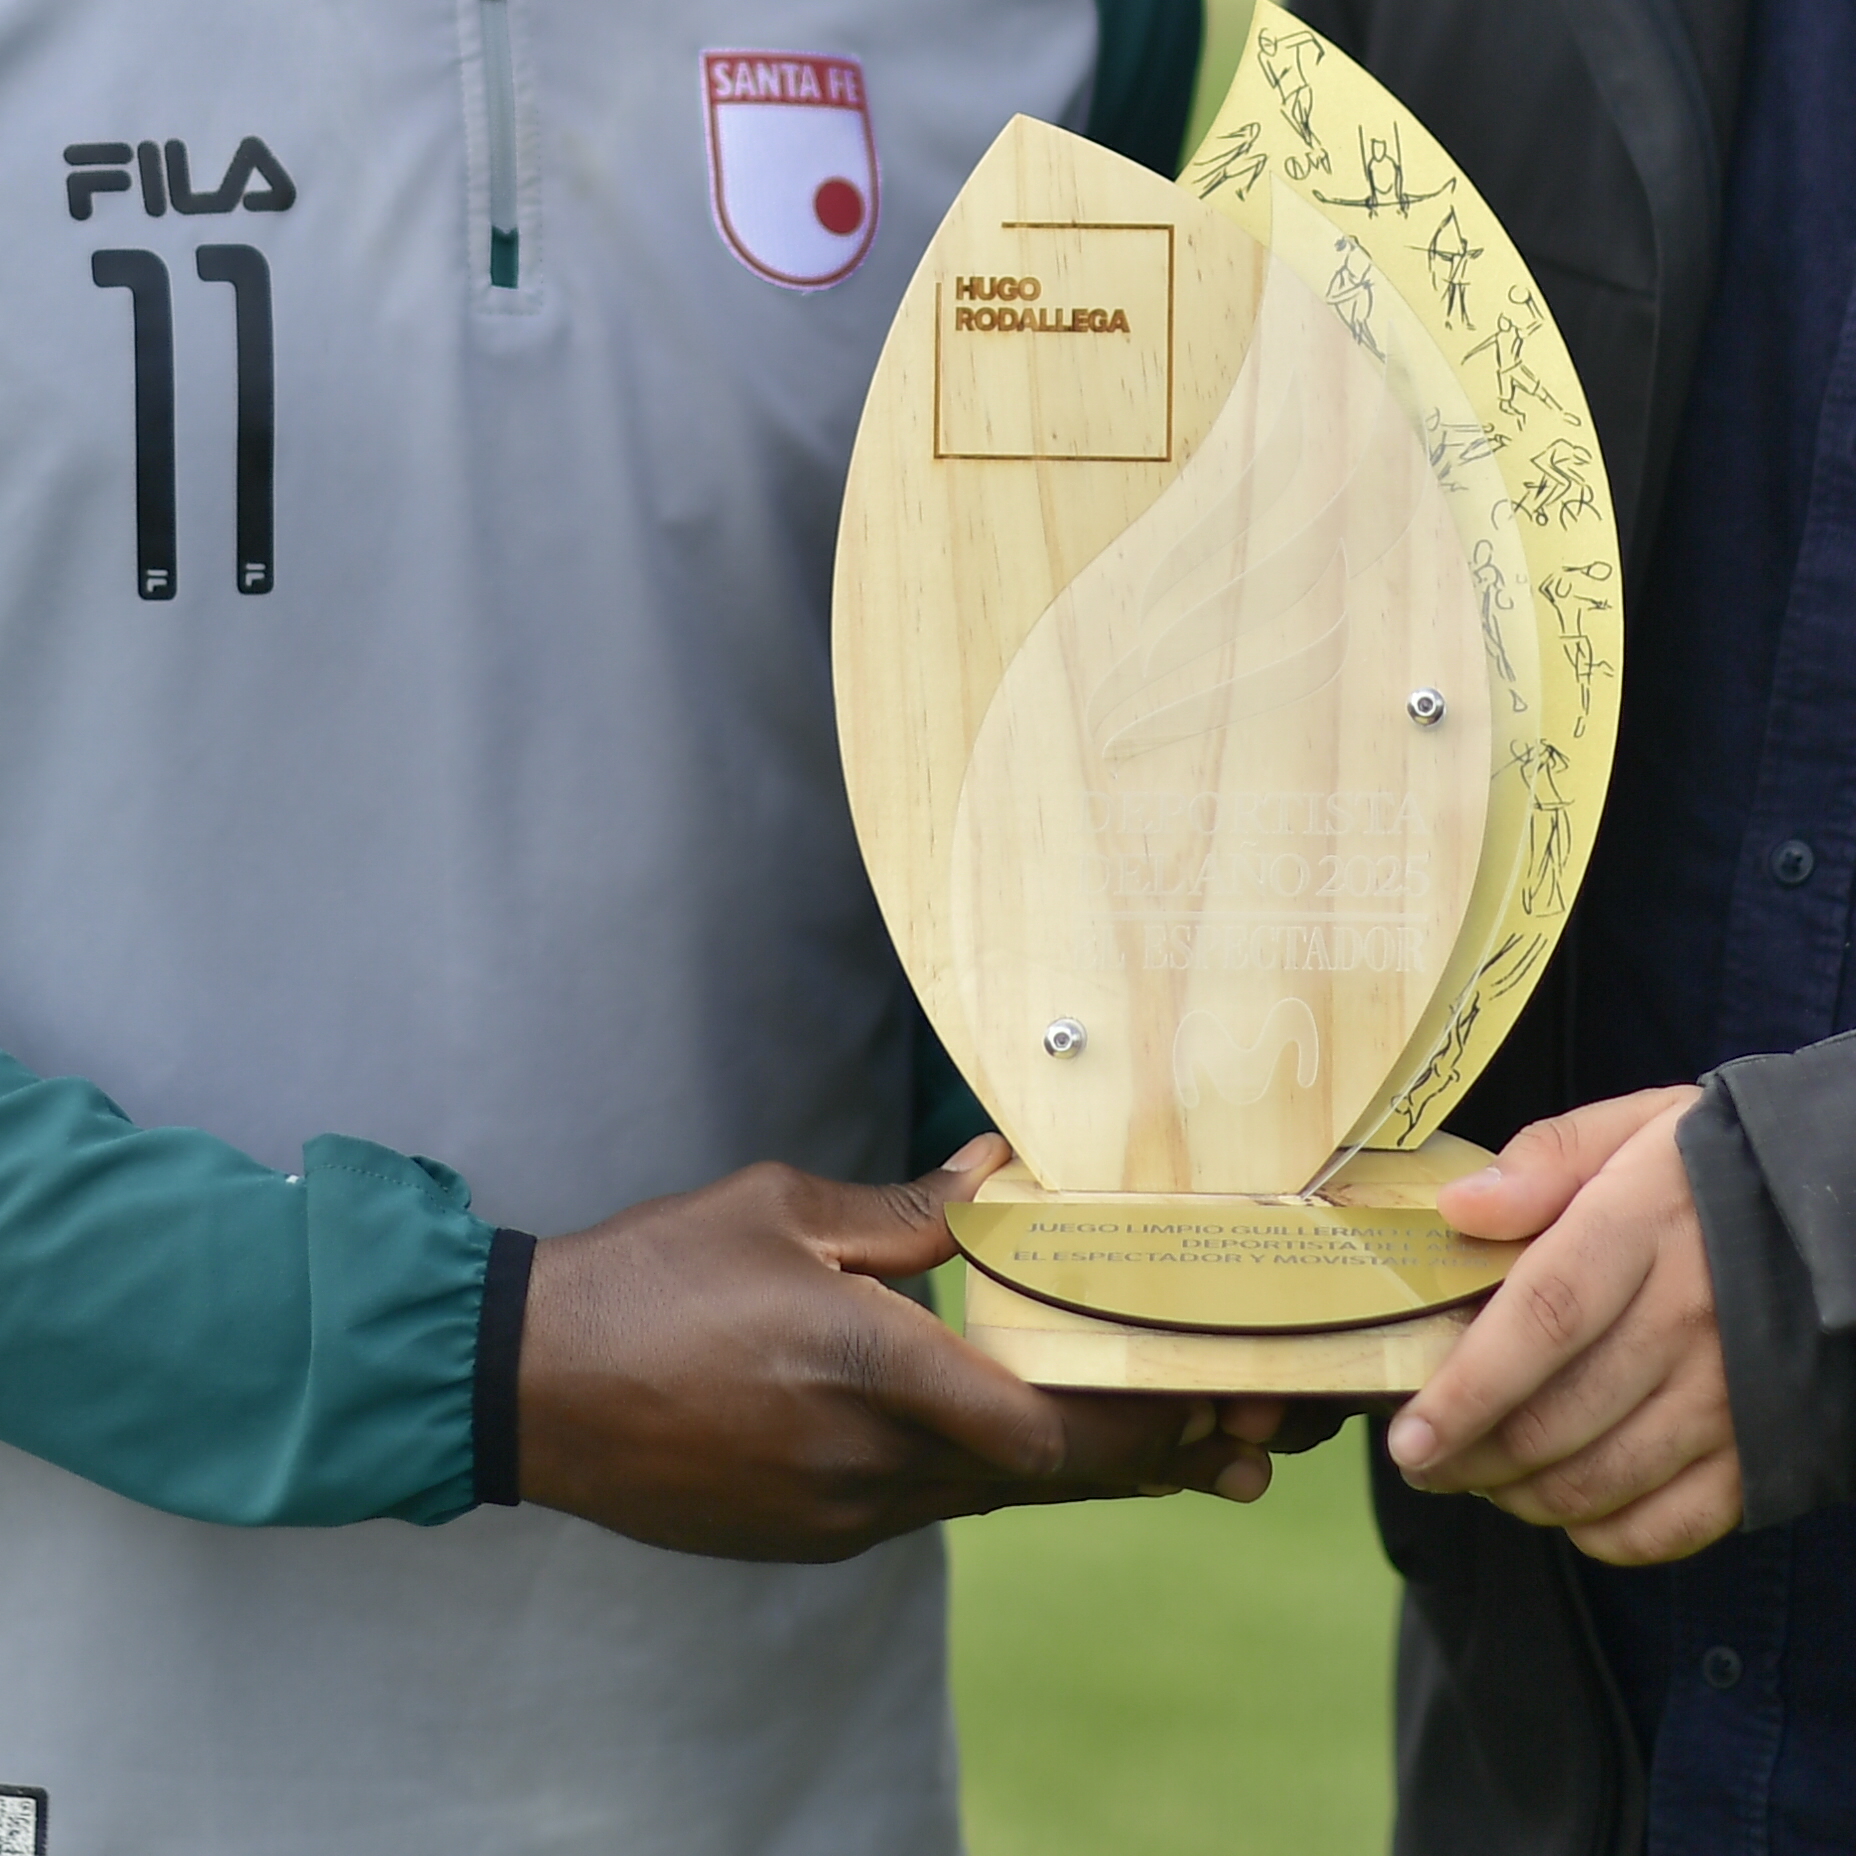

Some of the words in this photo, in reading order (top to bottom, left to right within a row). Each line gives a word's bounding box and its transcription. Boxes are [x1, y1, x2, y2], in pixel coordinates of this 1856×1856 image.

[713, 61, 822, 99] SANTA
[828, 67, 859, 103] FE
[63, 135, 297, 222] FILA
[955, 275, 1042, 301] HUGO
[955, 306, 1131, 333] RODALLEGA
[91, 244, 276, 601] 11
[1074, 790, 1431, 836] DEPORTISTA
[1074, 853, 1187, 897] DEL
[1187, 840, 1311, 898] AÑO
[1316, 853, 1432, 898] 2025
[1072, 924, 1125, 970] EL
[1142, 924, 1428, 973] ESPECTADOR
[1026, 1222, 1120, 1234] JUEGO
[1126, 1223, 1225, 1235] LIMPIO
[1230, 1224, 1399, 1238] GUILLERMO
[1181, 1238, 1358, 1251] DEPORTISTA
[1012, 1251, 1047, 1262] EL
[1052, 1251, 1243, 1264] ESPECTADOR
[1250, 1253, 1266, 1264] Y
[1272, 1253, 1420, 1266] MOVISTAR
